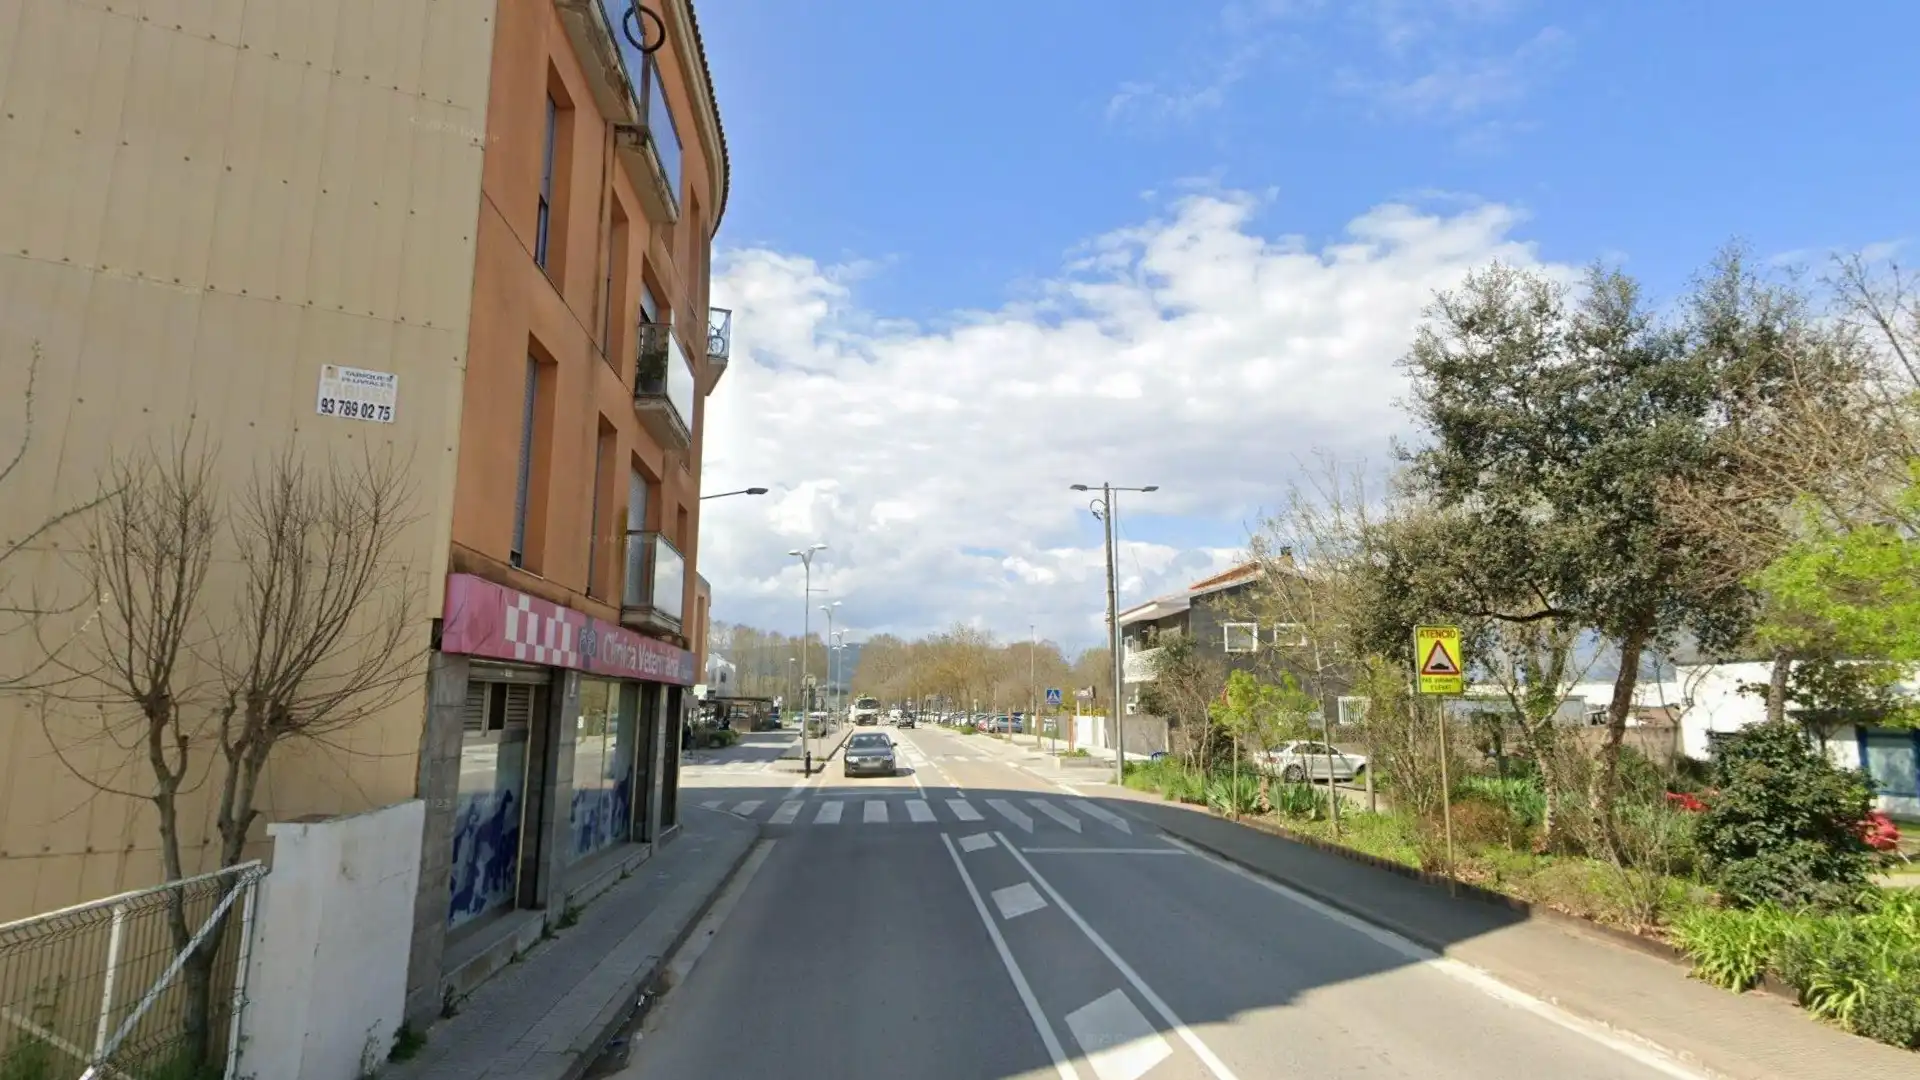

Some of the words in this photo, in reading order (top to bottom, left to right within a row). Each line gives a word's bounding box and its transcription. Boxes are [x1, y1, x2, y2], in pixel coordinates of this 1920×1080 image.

[321, 397, 335, 414] 93
[338, 400, 358, 417] 789
[361, 403, 375, 419] 02
[378, 405, 391, 421] 75
